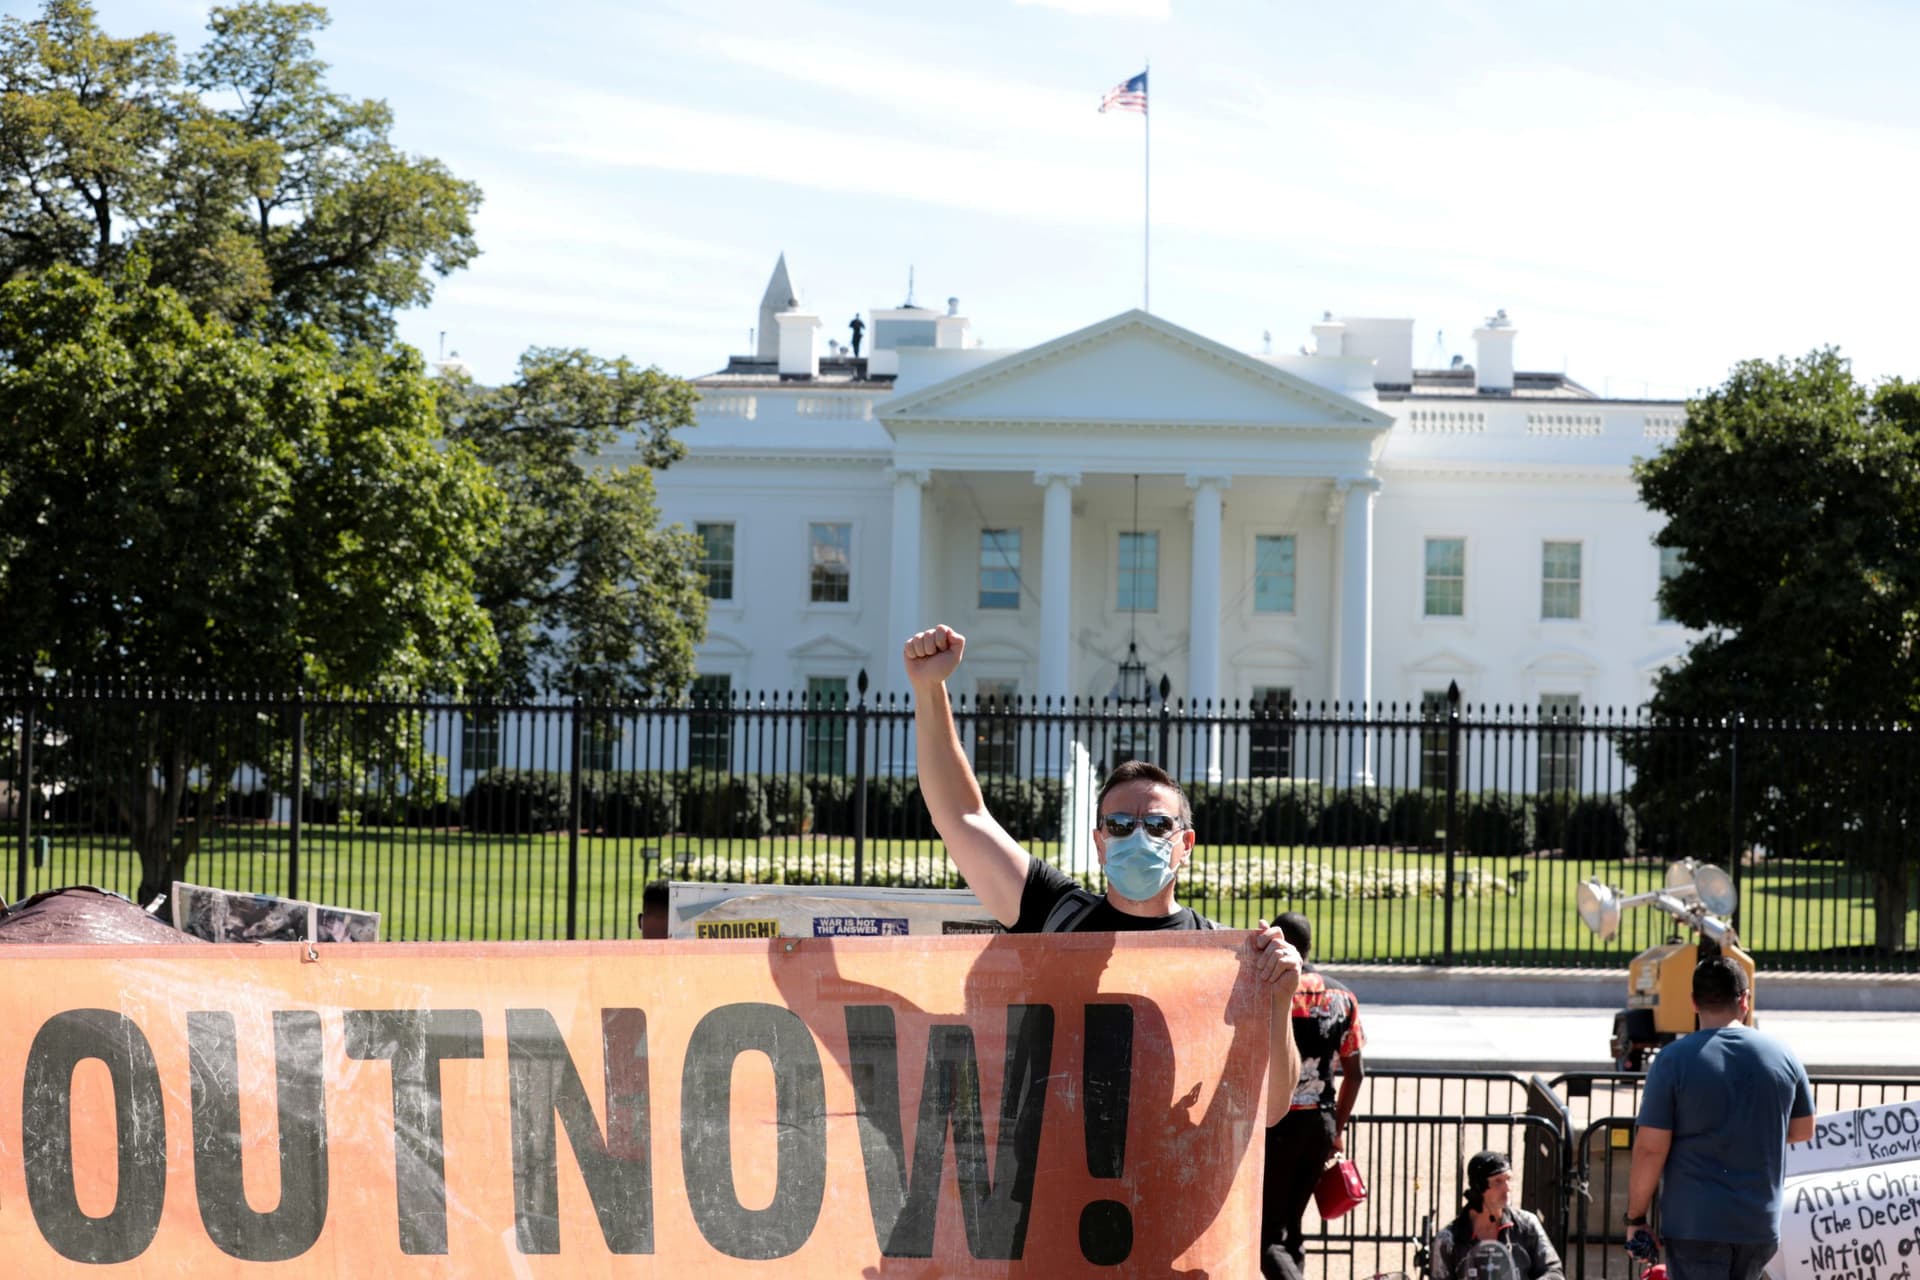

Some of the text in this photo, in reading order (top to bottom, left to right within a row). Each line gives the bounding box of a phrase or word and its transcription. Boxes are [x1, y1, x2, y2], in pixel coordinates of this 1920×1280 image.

[820, 918, 876, 927] WAR IS NOT
[697, 921, 776, 939] ENOUGH!
[817, 926, 878, 934] THE ANSWER
[1866, 1171, 1920, 1201] Chri
